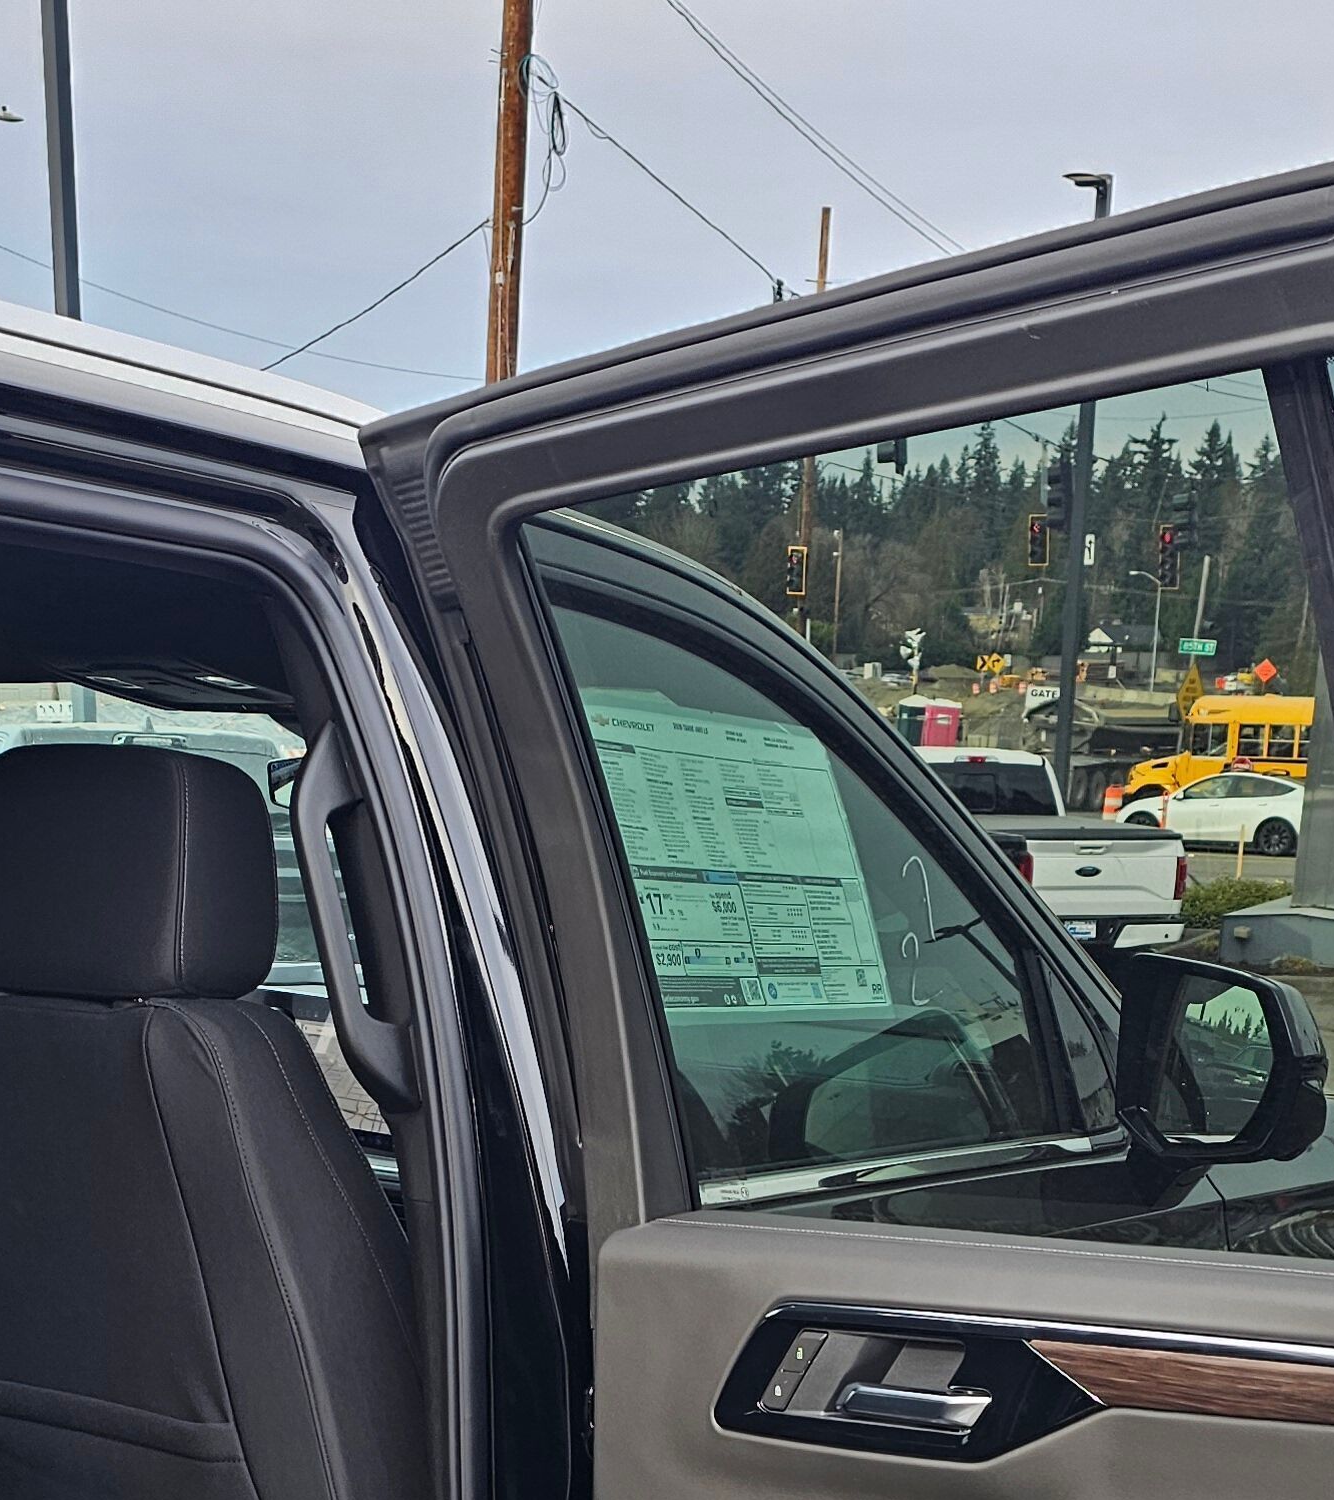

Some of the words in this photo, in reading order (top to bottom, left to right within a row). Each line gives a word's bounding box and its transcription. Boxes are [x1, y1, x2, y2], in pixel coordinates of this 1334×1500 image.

[1031, 688, 1058, 699] GATE
[612, 717, 655, 732] CHEVROLET
[646, 893, 664, 915] 17
[655, 952, 682, 967] $2,900
